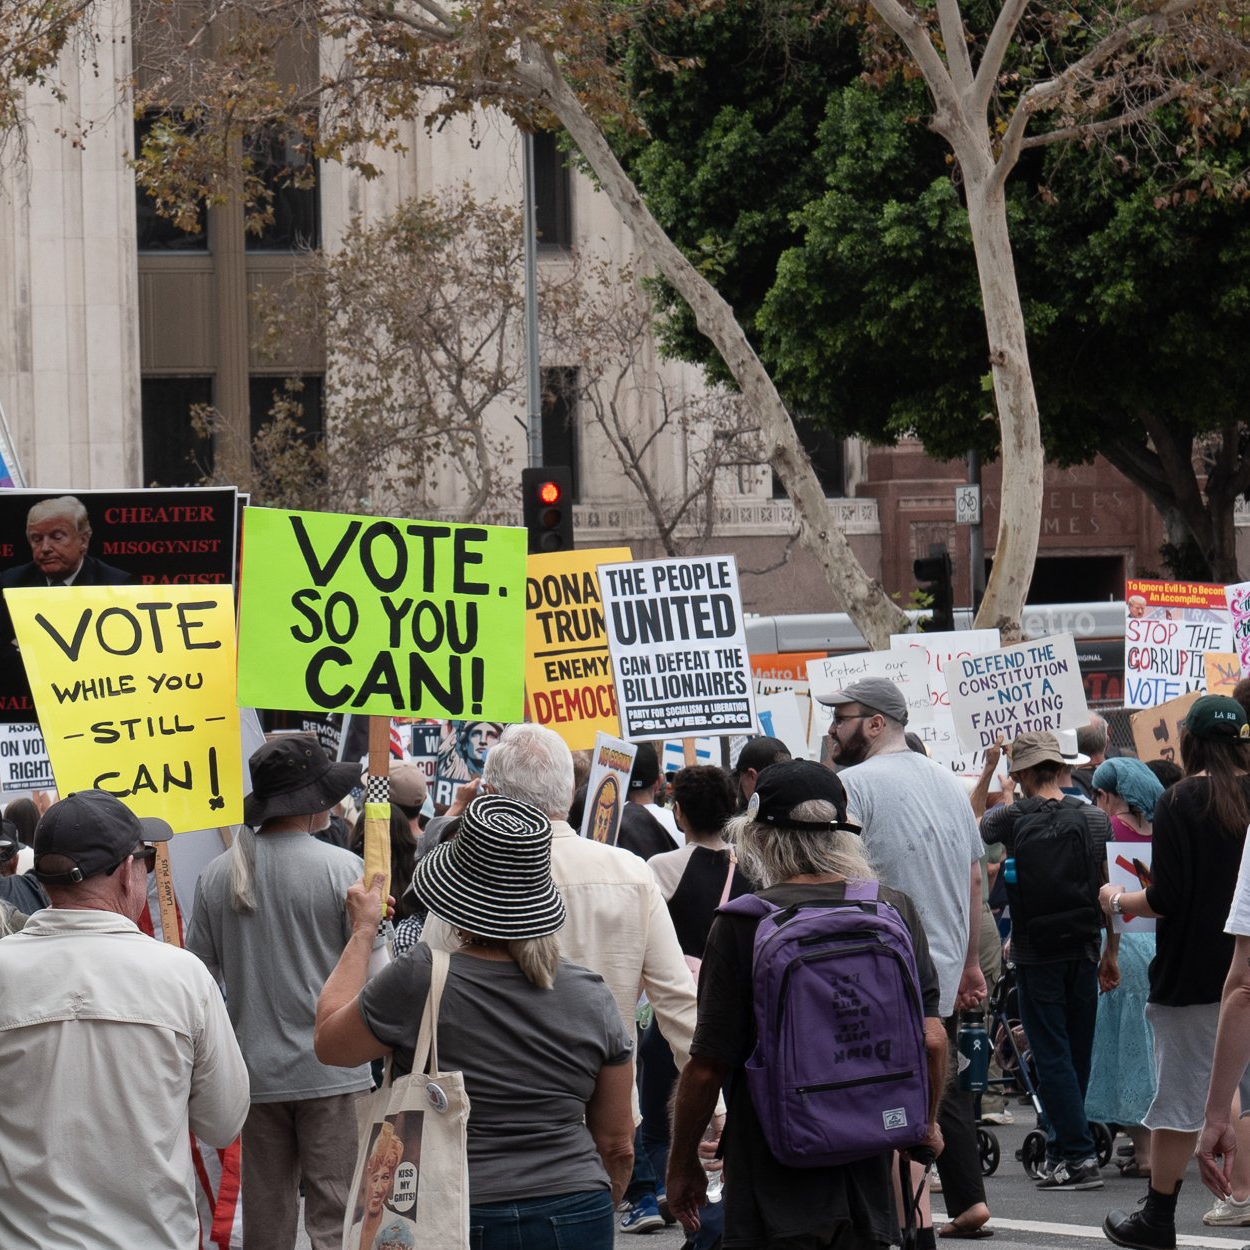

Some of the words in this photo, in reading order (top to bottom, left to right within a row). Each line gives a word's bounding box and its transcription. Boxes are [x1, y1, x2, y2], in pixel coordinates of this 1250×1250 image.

[104, 506, 215, 524] CHEATER
[103, 539, 221, 554] MISOGYNIST
[288, 515, 508, 597] VOTE.
[526, 571, 599, 610] DONA
[606, 568, 647, 597] THE
[652, 561, 732, 592] PEOPLE
[1127, 581, 1138, 590] To
[1139, 582, 1164, 593] Ignore
[1187, 585, 1197, 594] To
[1199, 586, 1225, 595] Becom
[1150, 592, 1160, 601] An
[34, 600, 222, 661] VOTE
[290, 588, 359, 644] SO
[380, 595, 478, 654] YOU
[610, 593, 737, 646] UNITED
[1025, 609, 1096, 636] etro
[1126, 619, 1179, 646] STOP
[1185, 624, 1222, 649] THE
[544, 655, 609, 682] ENEMY
[619, 655, 652, 676] CAN
[655, 652, 710, 674] DEFEAT
[714, 648, 744, 669] THE
[823, 659, 869, 678] Protect
[884, 660, 908, 671] our
[962, 651, 1025, 678] DEFEND
[1027, 644, 1056, 664] THE
[50, 674, 136, 704] WHILE
[147, 672, 203, 693] YOU
[305, 645, 485, 715] CAN!
[623, 670, 747, 703] BILLIONAIRES
[958, 659, 1069, 696] CONSTITUTION
[1042, 678, 1055, 695] A
[628, 709, 650, 720] PARTY
[651, 708, 665, 718] FOR
[665, 705, 703, 717] SOCIALISM
[704, 704, 710, 713] &
[710, 702, 747, 713] LIBERATION
[630, 713, 749, 731] PSLWEB.ORG
[971, 706, 1018, 729] FAUX
[1024, 694, 1064, 718] KING
[1214, 711, 1224, 719] LA
[979, 712, 1062, 747] DICTATOR!
[0, 740, 20, 757] ON
[22, 738, 46, 755] VOT
[9, 760, 54, 780] RIGHT
[93, 747, 225, 811] CAN!
[398, 1168, 413, 1178] KISS
[400, 1181, 410, 1189] MY
